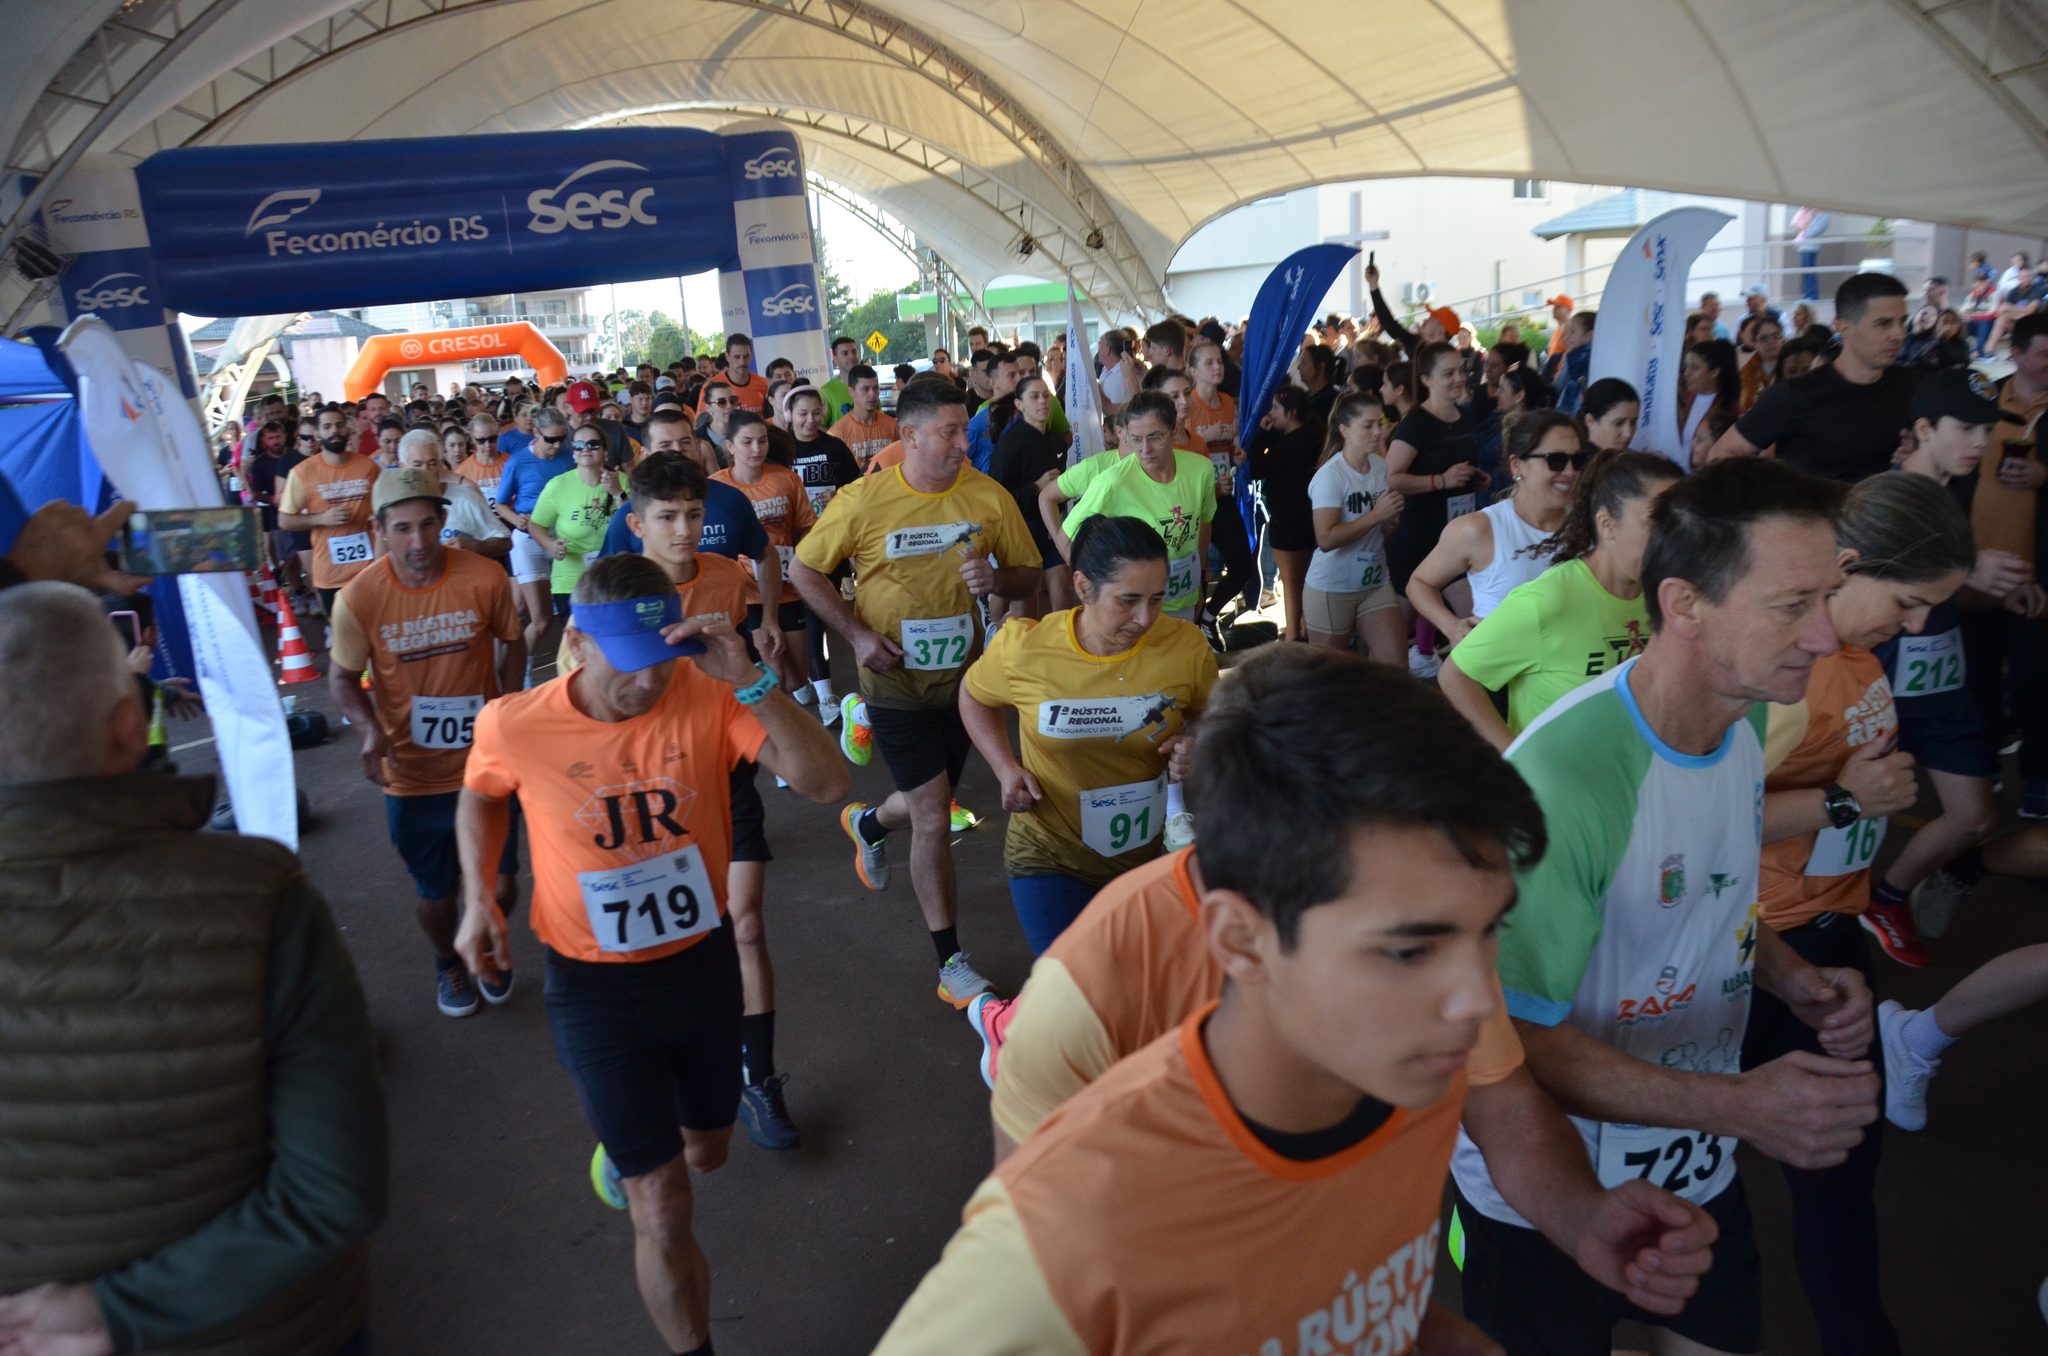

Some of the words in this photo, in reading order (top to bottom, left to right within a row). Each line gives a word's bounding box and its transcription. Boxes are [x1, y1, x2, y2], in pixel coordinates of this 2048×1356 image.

[744, 159, 798, 180] Sesc
[527, 186, 657, 235] Sesc
[266, 221, 441, 257] Fecomércio
[449, 215, 489, 242] RS
[749, 231, 799, 246] Fecomércio
[75, 286, 150, 311] Sesc
[761, 295, 815, 317] Sesc
[428, 333, 507, 354] CRESOL
[336, 544, 367, 562] 529
[698, 535, 728, 546] ners
[402, 609, 479, 635] RÚSTICA
[387, 624, 476, 653] REGIONAL
[914, 635, 967, 666] 372
[1905, 653, 1960, 692] 212
[1068, 716, 1124, 725] REGIONAL
[1071, 706, 1117, 716] RÚSTICA
[422, 717, 475, 744] 705
[594, 789, 690, 851] JR
[1110, 806, 1150, 850] 91
[602, 884, 700, 944] 719
[1624, 1132, 1722, 1193] 723
